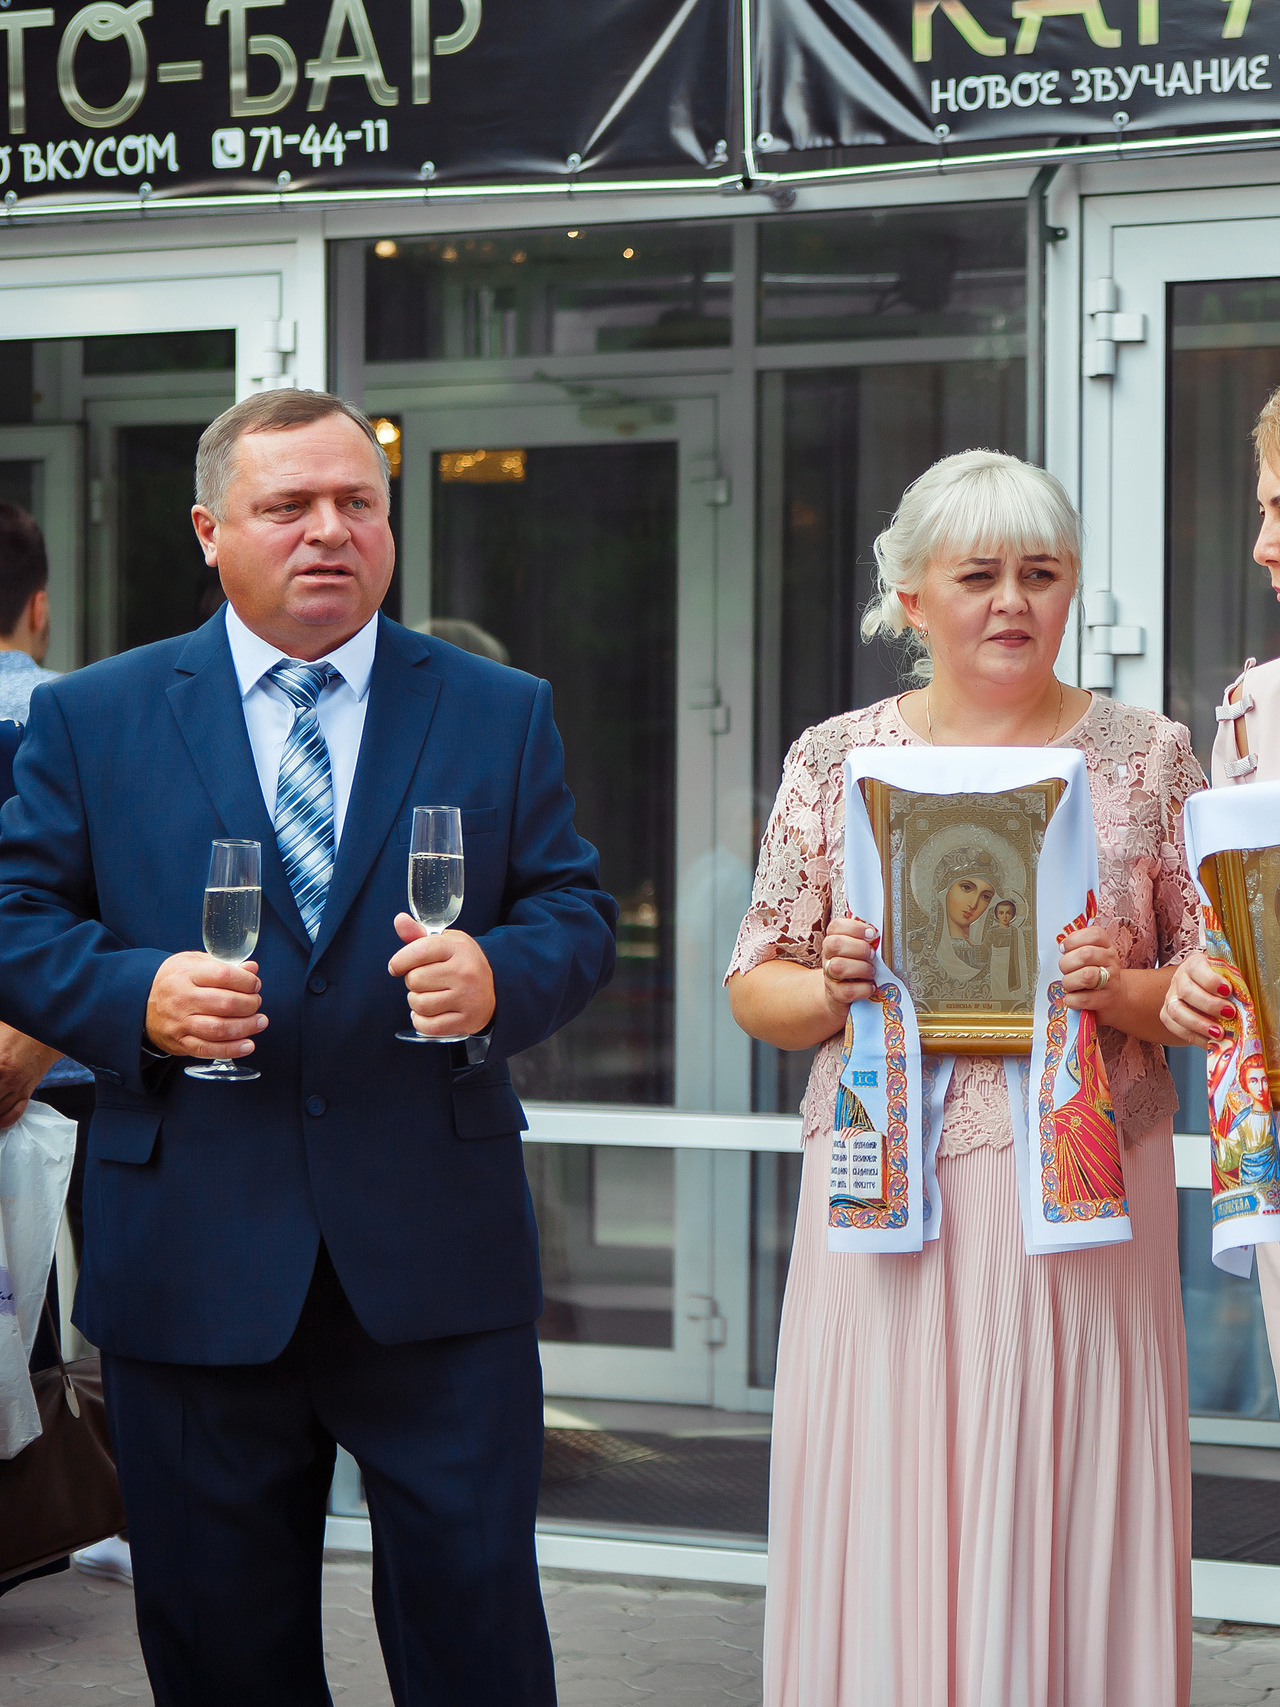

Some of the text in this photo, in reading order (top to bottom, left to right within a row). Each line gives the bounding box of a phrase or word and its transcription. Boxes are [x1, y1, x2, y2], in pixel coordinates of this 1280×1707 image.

[930, 69, 1063, 114] НОВОЕ
[1069, 53, 1273, 104] ЗВУЧАНИЕ
[18, 131, 180, 183] ВКУСОМ
[249, 118, 389, 172] 71-44-11
